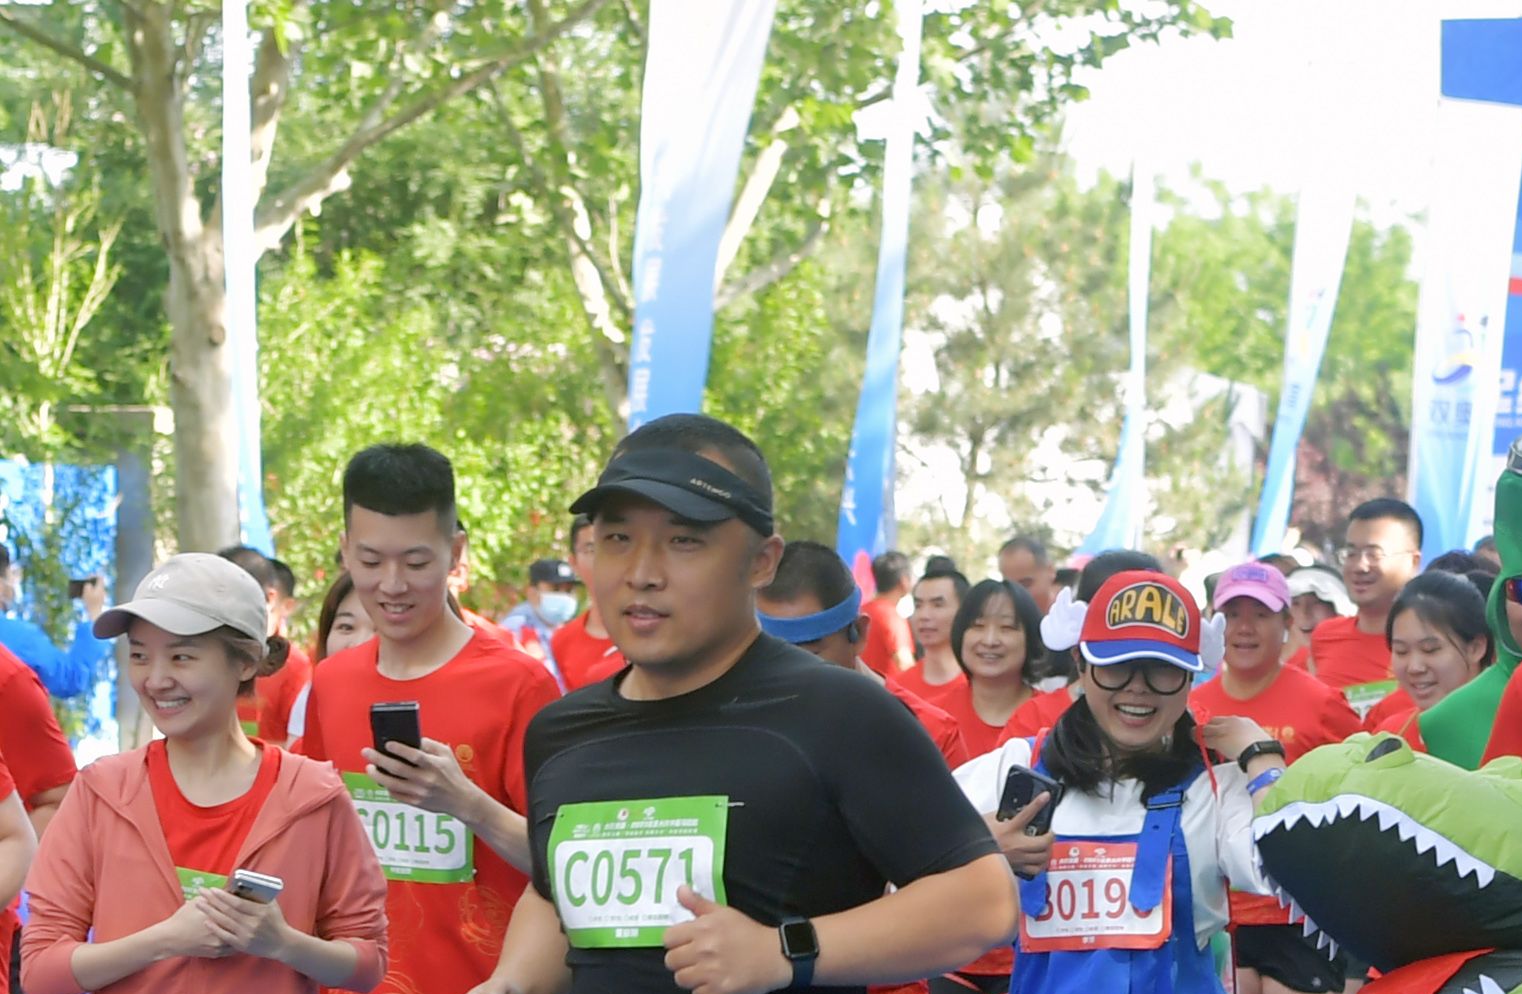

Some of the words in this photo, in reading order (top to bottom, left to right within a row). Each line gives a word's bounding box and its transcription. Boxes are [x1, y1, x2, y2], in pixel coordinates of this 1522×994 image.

[1110, 586, 1185, 633] ARALE
[357, 807, 456, 855] 0115
[564, 847, 694, 907] C0571
